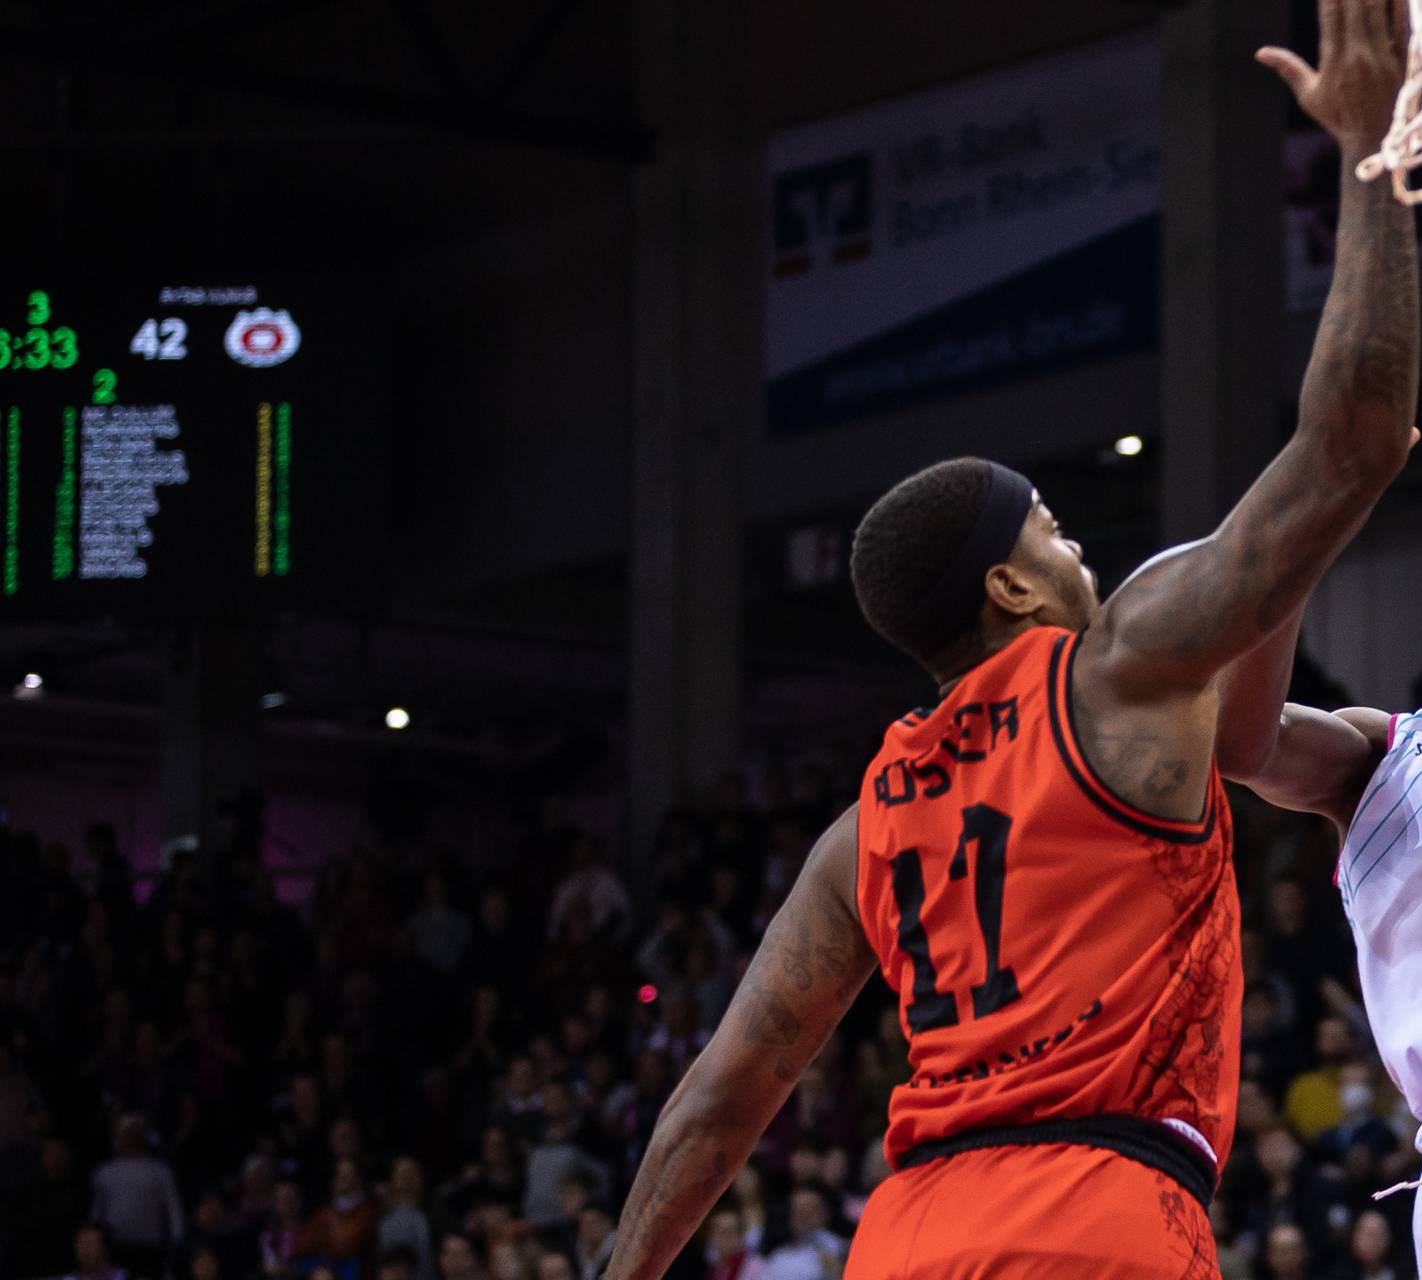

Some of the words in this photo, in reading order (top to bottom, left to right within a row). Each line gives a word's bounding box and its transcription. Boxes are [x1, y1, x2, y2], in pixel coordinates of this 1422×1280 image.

[28, 291, 50, 325] 3
[131, 318, 187, 359] 42
[93, 369, 117, 404] 2
